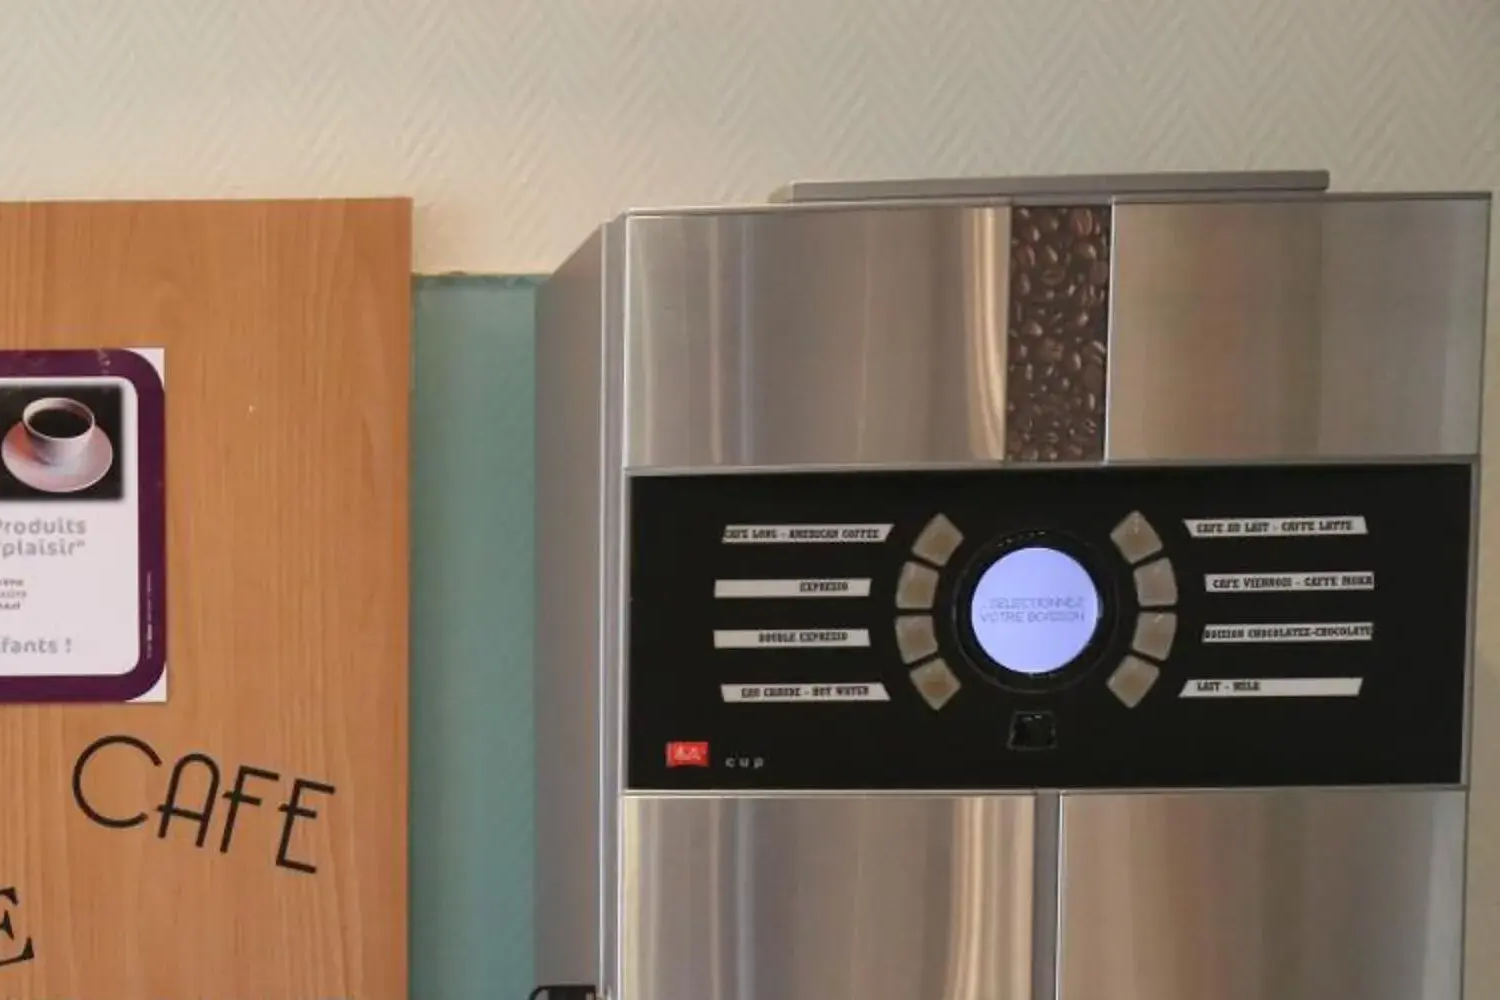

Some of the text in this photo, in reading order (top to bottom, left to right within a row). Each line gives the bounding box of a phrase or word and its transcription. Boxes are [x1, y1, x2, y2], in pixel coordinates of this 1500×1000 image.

[841, 528, 880, 538] COFFEE
[65, 637, 73, 654] !
[725, 757, 764, 769] cup
[72, 735, 336, 875] CAFE
